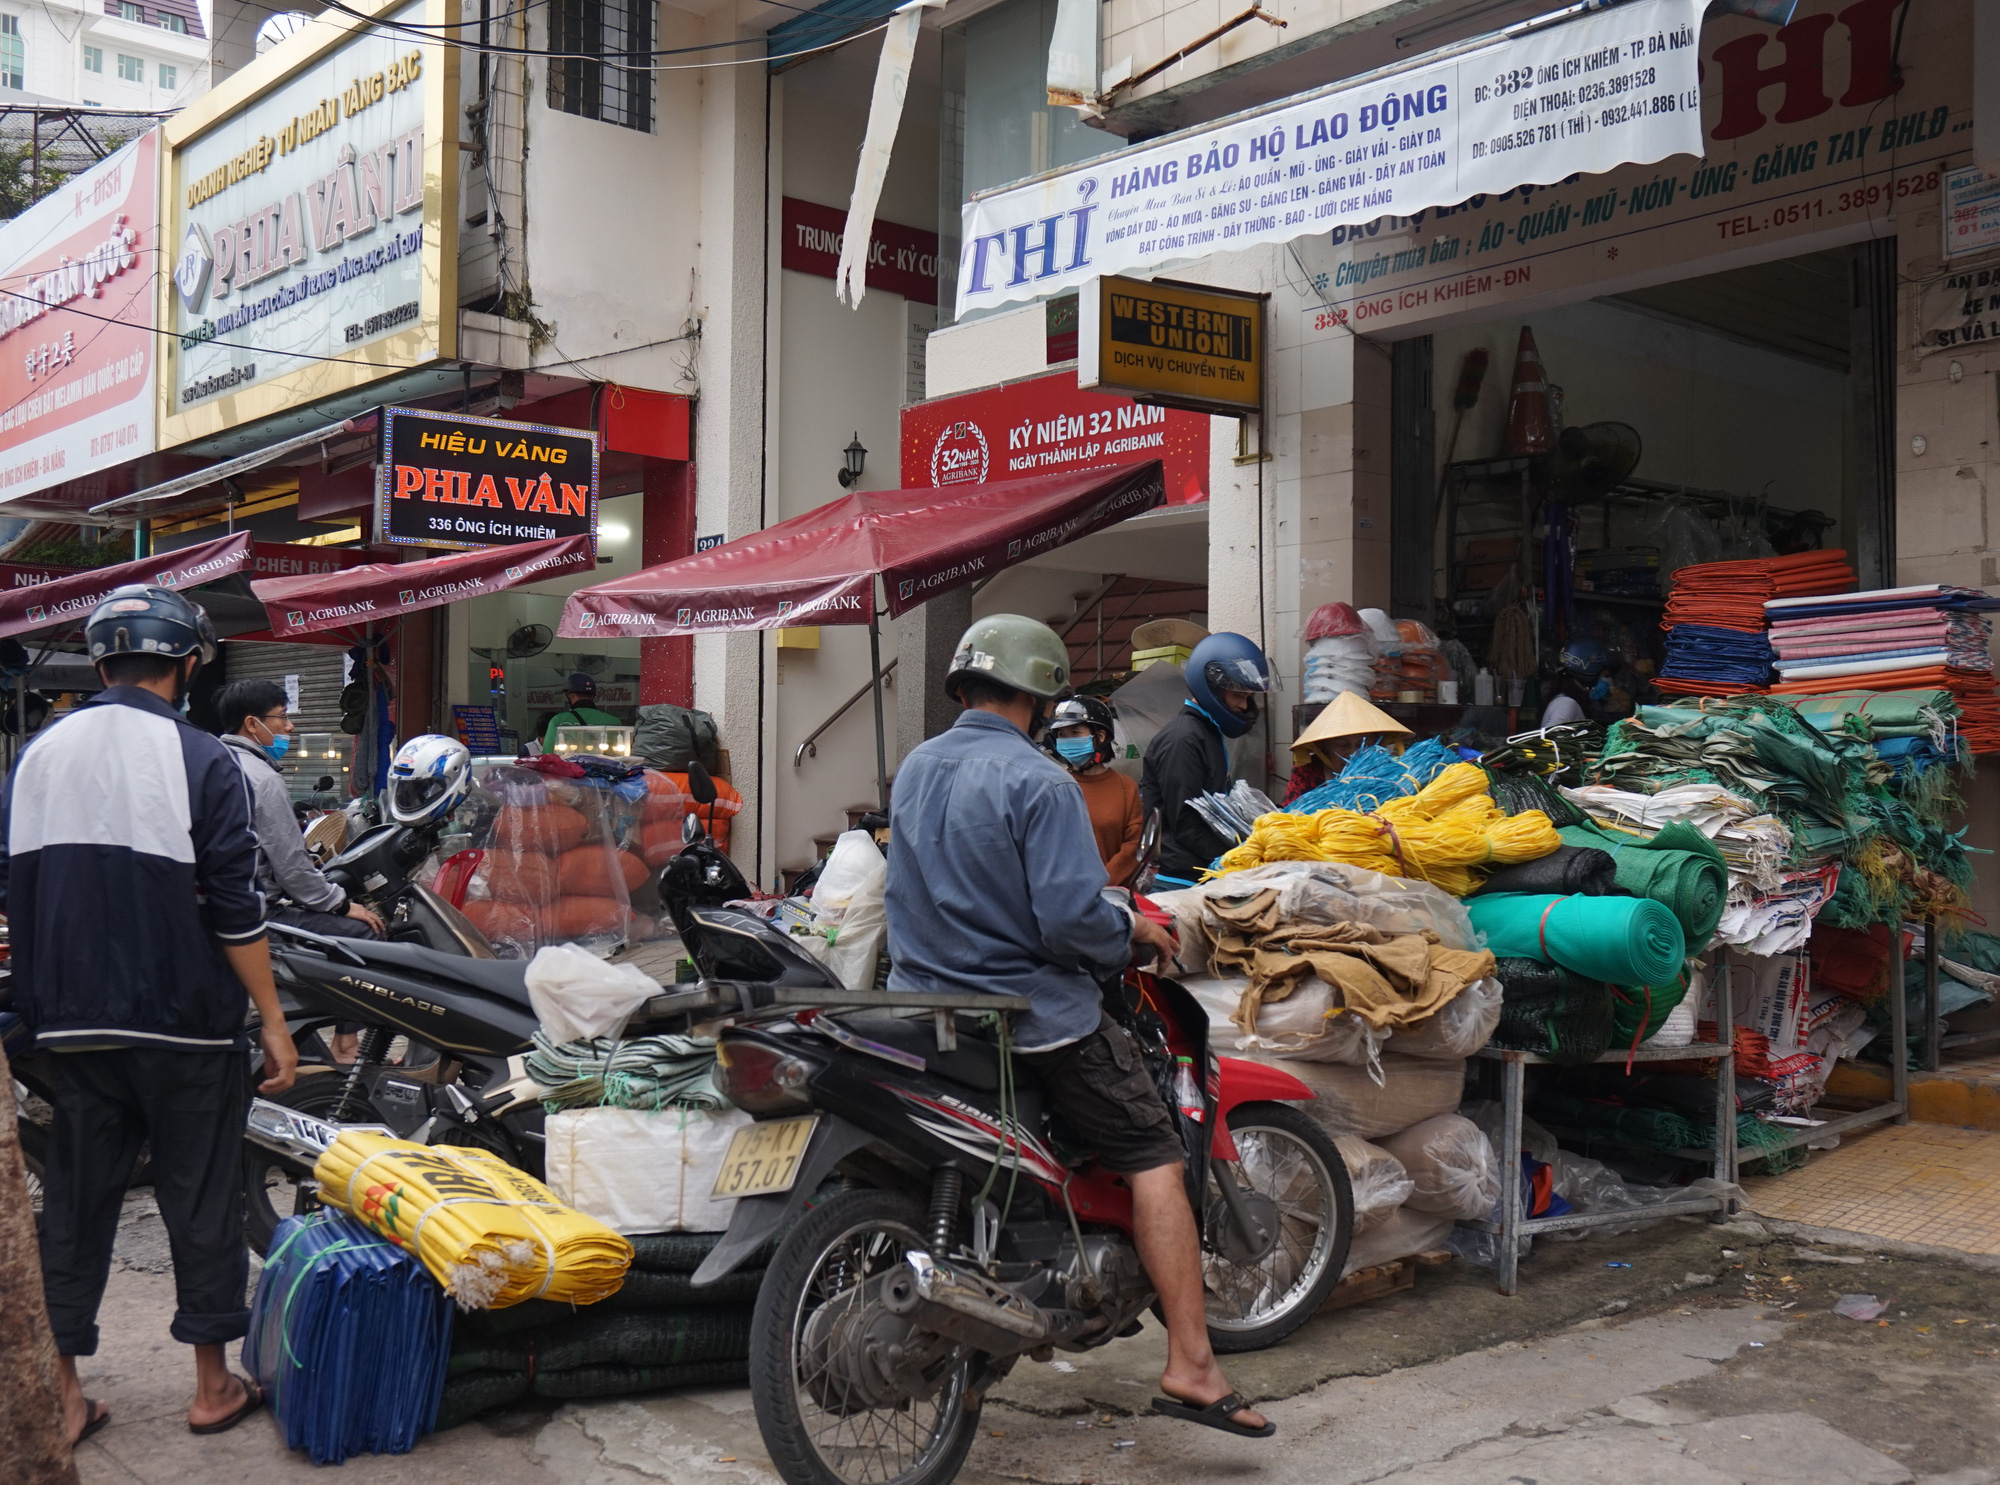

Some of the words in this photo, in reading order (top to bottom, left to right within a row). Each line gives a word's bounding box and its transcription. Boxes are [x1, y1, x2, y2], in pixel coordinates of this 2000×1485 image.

[1474, 85, 1492, 104] ĐC:
[1493, 65, 1534, 98] 332
[1537, 65, 1559, 86] ÔNG
[1562, 57, 1581, 77] ÍCH
[1584, 46, 1620, 73] KHIÊM
[1630, 40, 1645, 60] TP.
[1648, 30, 1666, 54] ĐÀ
[1513, 101, 1537, 122] ĐIỆN
[1541, 89, 1576, 112] THOẠI:
[1578, 67, 1656, 104] 0236.3891528
[187, 165, 227, 209] DOANH
[227, 137, 275, 186] NGHIỆP
[277, 118, 298, 156] TƯ
[299, 98, 339, 146] NHÂN
[342, 79, 384, 118] VÀNG
[386, 49, 421, 92] BẠC
[1111, 165, 1179, 199] HÀNG
[1187, 140, 1240, 179] BẢO
[1249, 125, 1286, 163] HỘ
[1295, 112, 1349, 151] LAO
[1359, 84, 1447, 133] ĐỘNG
[1490, 129, 1535, 154] 0905.526
[1538, 123, 1557, 142] 781
[1568, 111, 1585, 136] THỈ
[1601, 94, 1676, 128] 0932.441.886
[1238, 175, 1251, 192] ÁO
[1253, 167, 1281, 189] QUẦN
[1289, 160, 1305, 180] MŨ
[1315, 154, 1336, 173] ỦNG
[1345, 145, 1369, 166] GIÀY
[1371, 137, 1389, 158] VẢI
[1399, 131, 1424, 152] GIÀY
[1427, 127, 1441, 144] DA
[75, 190, 83, 218] K
[94, 165, 122, 207] DISH
[1126, 219, 1143, 237] DÂY
[1145, 216, 1158, 233] DÙ
[1166, 212, 1179, 229] ÁO
[1182, 210, 1203, 226] MƯA
[1211, 200, 1236, 220] GĂNG
[1239, 198, 1251, 216] SU
[1260, 189, 1288, 209] GĂNG
[1290, 185, 1309, 202] LEN
[1318, 177, 1346, 195] GĂNG
[1349, 168, 1366, 188] VẢI
[1376, 163, 1396, 182] DÂY
[1399, 158, 1414, 177] AN
[1417, 150, 1446, 171] TOÀN
[1335, 254, 1390, 287] Chuyên
[1392, 246, 1424, 273] mua
[1429, 236, 1460, 262] bán
[1477, 220, 1504, 253] ÁO
[1517, 200, 1571, 245] QUẦN
[1581, 188, 1617, 227] MŨ
[1628, 175, 1677, 215] NÓN
[1690, 158, 1738, 200] ỦNG
[1751, 140, 1818, 186] GĂNG
[1827, 125, 1873, 166] TAY
[1879, 105, 1948, 153] BHLĐ
[212, 192, 307, 299] PHIA
[304, 143, 397, 253] VÂN
[962, 176, 1099, 294] THỈ
[1139, 240, 1157, 256] BẠT
[1159, 232, 1185, 251] CÔNG
[1187, 227, 1215, 246] TRÌNH
[1223, 221, 1242, 239] DÂY
[1245, 214, 1276, 235] THỪNG
[1285, 209, 1305, 226] BAO
[1315, 200, 1337, 219] LƯỚI
[1340, 196, 1360, 214] CHE
[1363, 187, 1392, 208] NẮNG
[44, 256, 84, 310] HÀN
[84, 213, 136, 299] QUỐC
[796, 224, 845, 254] TRUNG
[897, 244, 915, 273] KỶ
[308, 271, 336, 296] TRANG
[1314, 309, 1348, 331] 332
[1355, 297, 1393, 320] ÔNG
[1398, 288, 1428, 311] ÍCH
[1434, 275, 1491, 303] KHIÊM
[1504, 266, 1531, 286] ĐN
[1112, 295, 1228, 335] WESTERN
[1961, 321, 1986, 341] VÀ
[1150, 325, 1228, 358] UNION
[55, 378, 82, 411] MELAMIN
[83, 370, 96, 398] HÀN
[97, 358, 114, 394] QUỐC
[115, 358, 128, 384] CAO
[130, 344, 144, 379] CẤP
[1114, 351, 1144, 369] DỊCH
[1148, 357, 1164, 373] VỤ
[1167, 359, 1216, 379] CHUYỂN
[1219, 365, 1245, 382] TIỀN
[100, 431, 114, 454] 0797
[115, 427, 126, 449] 140
[127, 423, 138, 446] 074
[420, 430, 487, 456] HIỆU
[495, 439, 568, 464] VÀNG
[1009, 419, 1032, 450] KỶ
[1037, 414, 1085, 448] NIỆM
[1089, 410, 1112, 436] 32
[941, 448, 960, 471] 32
[959, 448, 979, 461] NĂM
[1009, 452, 1038, 471] NGÀY
[1039, 448, 1077, 468] THÀNH
[1079, 442, 1100, 461] LẬP
[1105, 432, 1164, 455] AGRIBANK
[394, 464, 503, 508] PHIA
[505, 471, 589, 517] VÂN
[941, 467, 978, 481] AGRIBANK
[1106, 481, 1165, 512] AGRIBANK
[429, 517, 452, 531] 336
[455, 517, 486, 533] ÔNG
[489, 520, 512, 536] ÍCH
[515, 524, 556, 540] KHIÊM
[1023, 517, 1080, 550] AGRIBANK
[179, 548, 251, 581] AGRIBANK
[255, 554, 303, 574] CHÉN
[308, 556, 342, 574] BÁT
[524, 551, 586, 574] AGRIBANK
[916, 555, 986, 591] AGRIBANK
[417, 577, 485, 600] AGRIBANK
[791, 595, 861, 615] AGRIBANK
[307, 599, 376, 621] AGRIBANK
[596, 613, 656, 626] AGRIBANK
[692, 606, 755, 623] AGRIBANK
[339, 975, 446, 1016] AIRBLADE
[739, 1122, 801, 1158] 75-K1
[722, 1155, 796, 1192] 157.07
